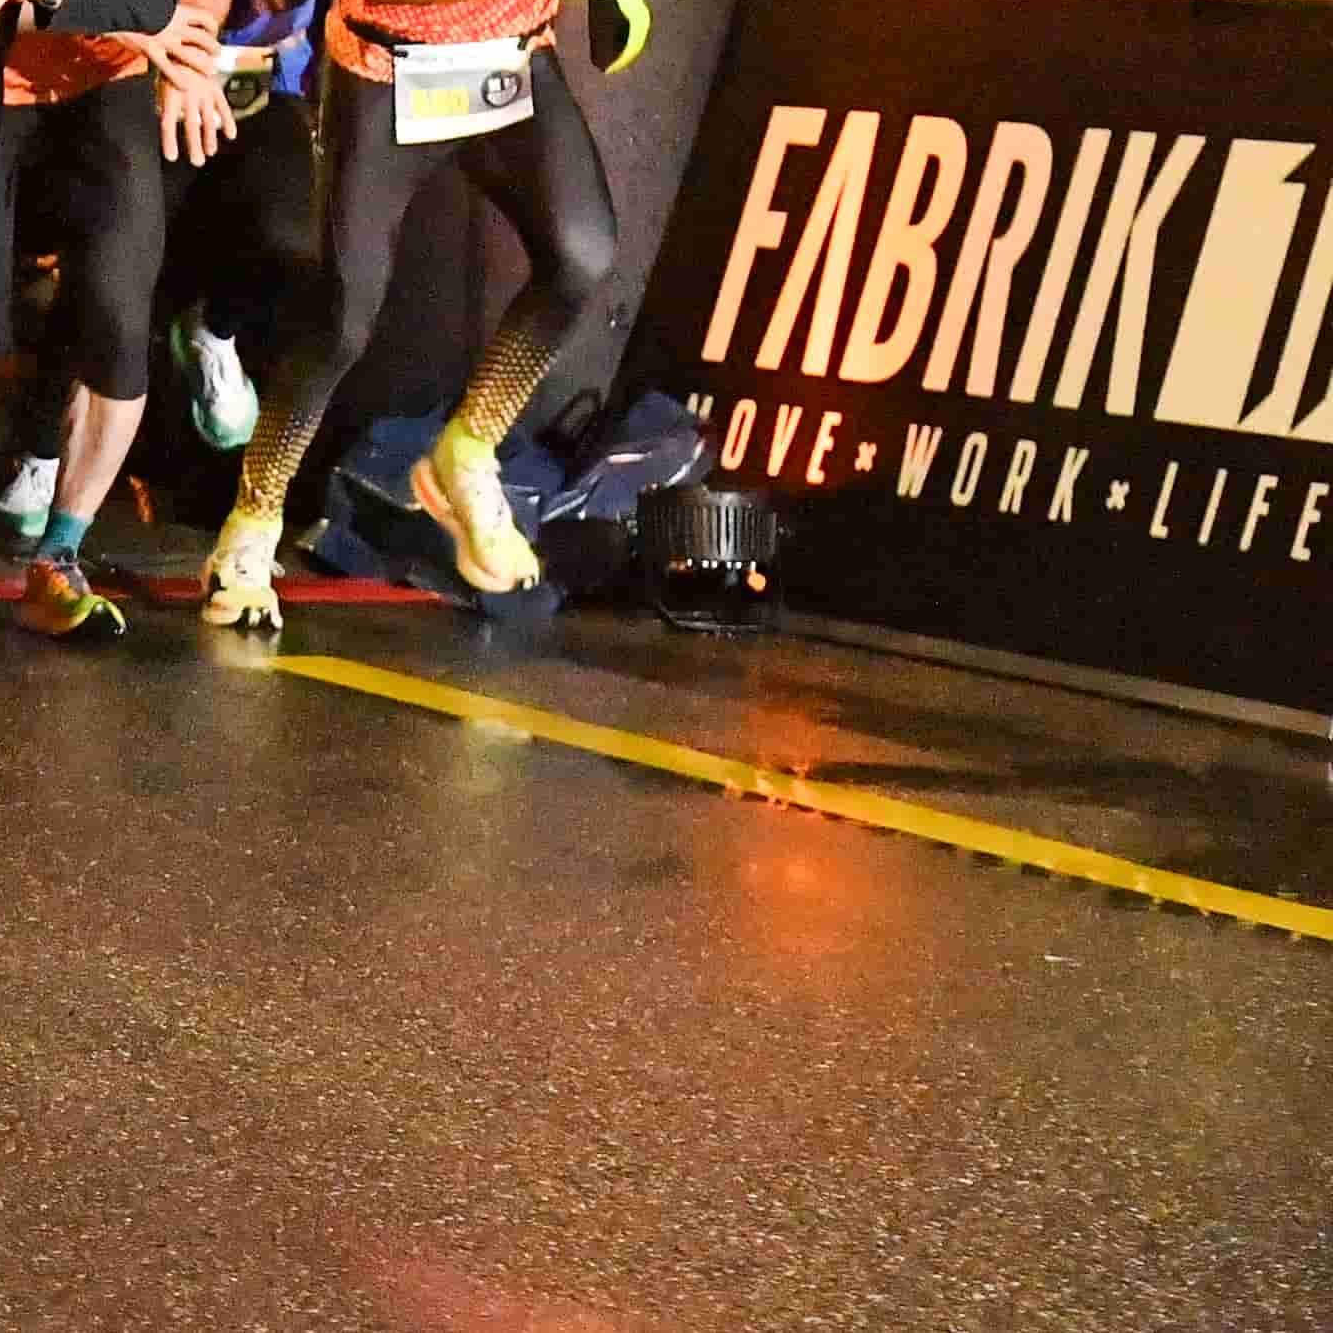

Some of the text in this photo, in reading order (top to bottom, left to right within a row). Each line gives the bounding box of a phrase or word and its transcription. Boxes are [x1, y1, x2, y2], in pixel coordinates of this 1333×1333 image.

[700, 105, 1206, 417] FABRIK
[896, 423, 1089, 524] WORK
[1149, 461, 1330, 561] LIFE
